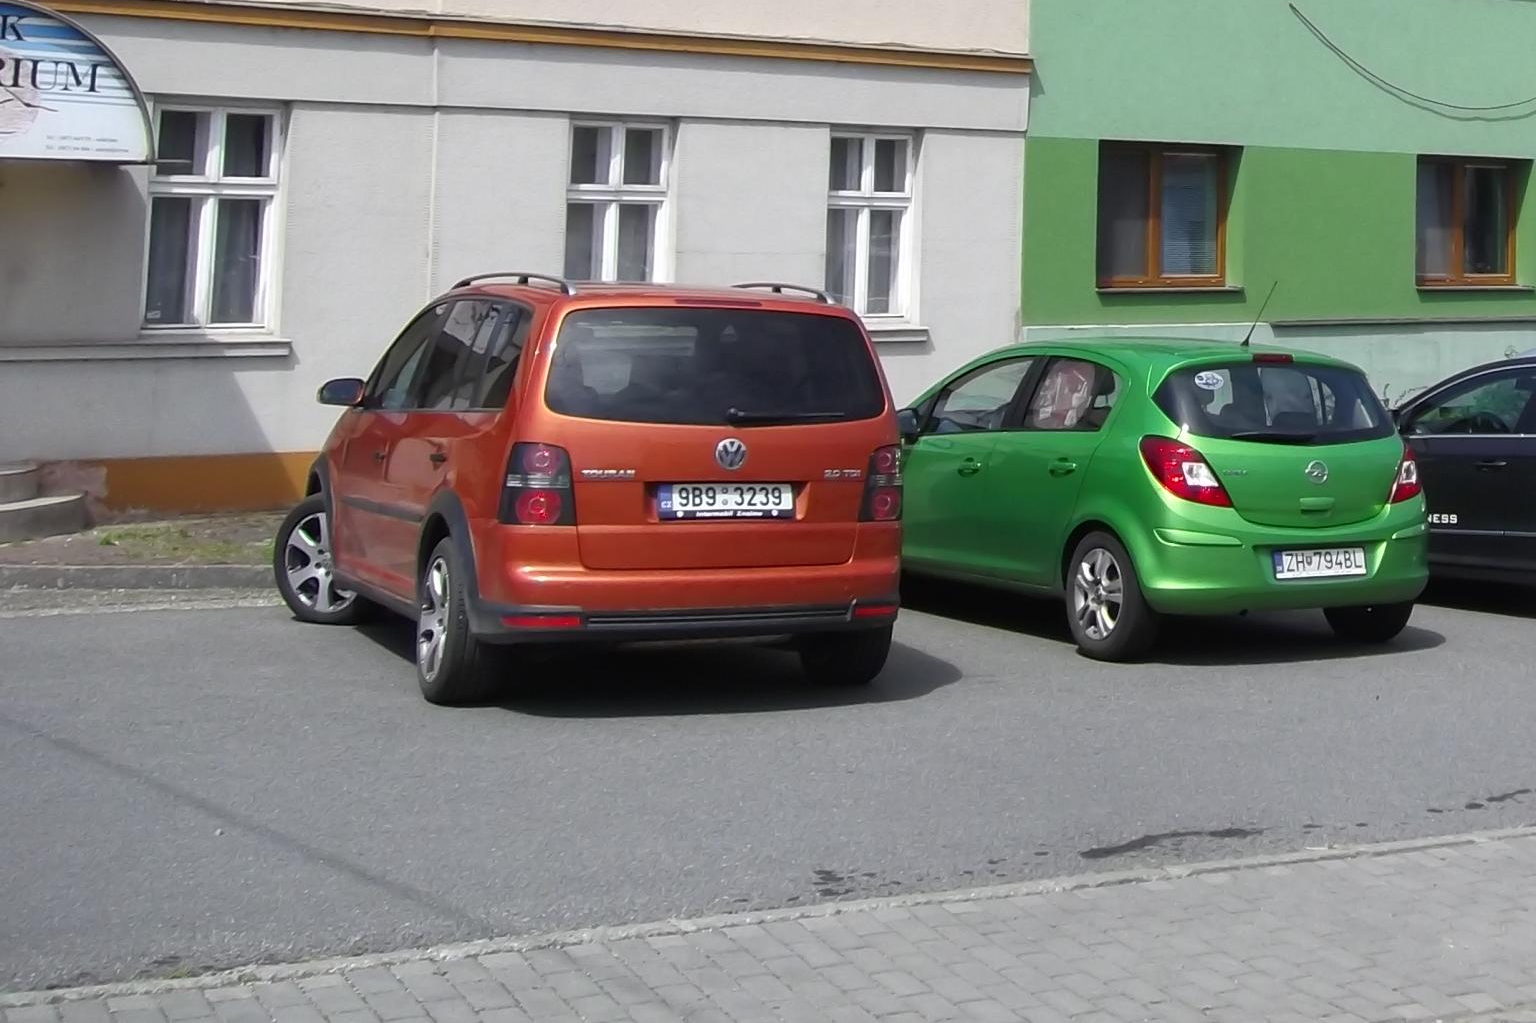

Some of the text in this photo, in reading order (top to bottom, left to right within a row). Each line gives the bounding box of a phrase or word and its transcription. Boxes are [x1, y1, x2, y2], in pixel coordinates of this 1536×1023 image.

[0, 15, 29, 41] K
[678, 486, 717, 507] 9B9
[733, 486, 783, 506] 3239
[1313, 549, 1363, 570] 794BL
